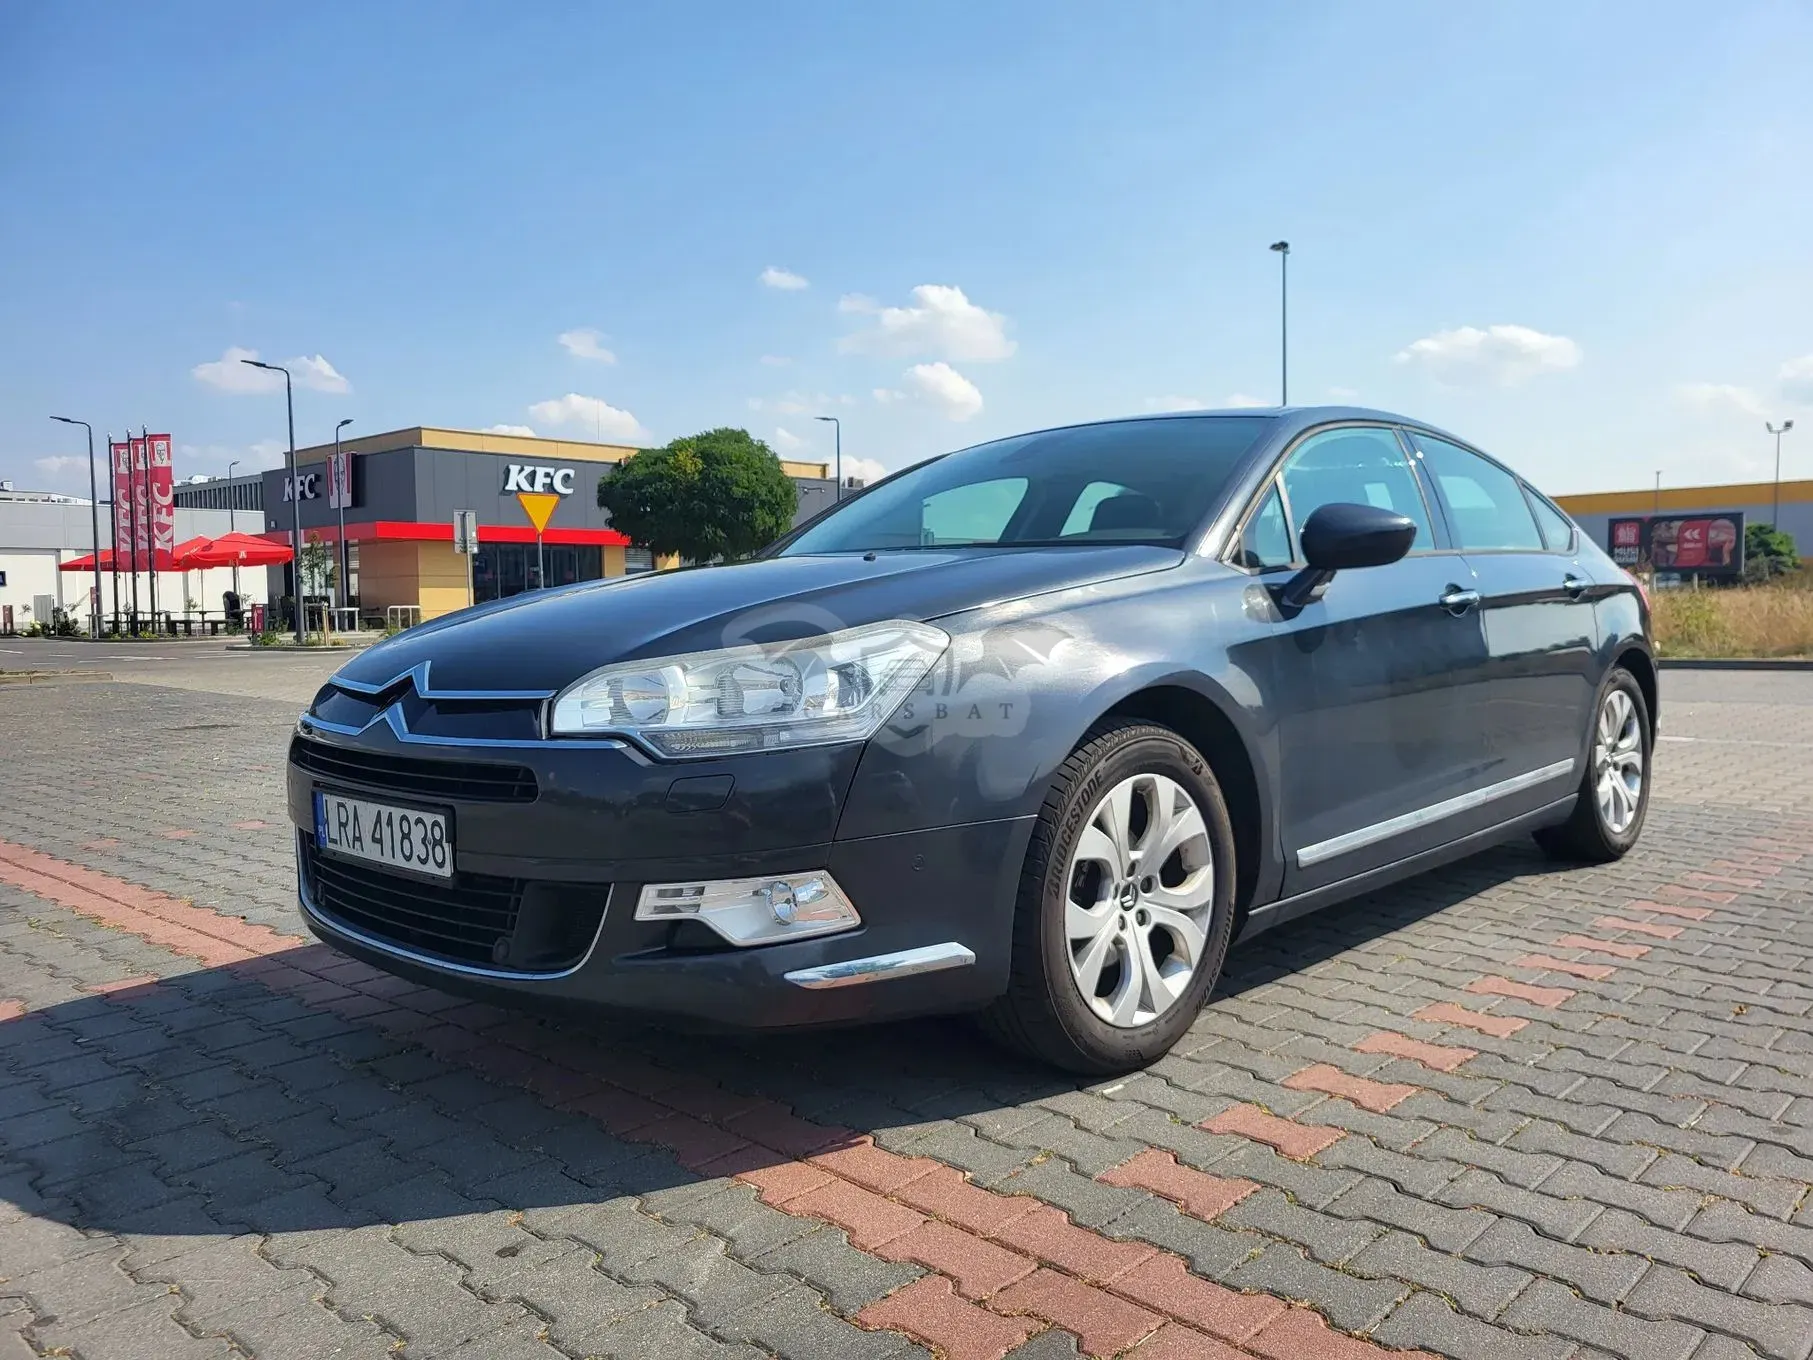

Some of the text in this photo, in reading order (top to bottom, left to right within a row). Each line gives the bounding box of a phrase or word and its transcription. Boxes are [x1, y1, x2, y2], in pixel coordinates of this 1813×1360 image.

[283, 474, 315, 501] KFC
[505, 464, 575, 494] KFC
[118, 488, 131, 552] KFC
[136, 485, 149, 550] KFC
[153, 482, 173, 553] KFC
[324, 798, 446, 869] LRA 41838
[1047, 769, 1104, 899] BRIDGESTONE
